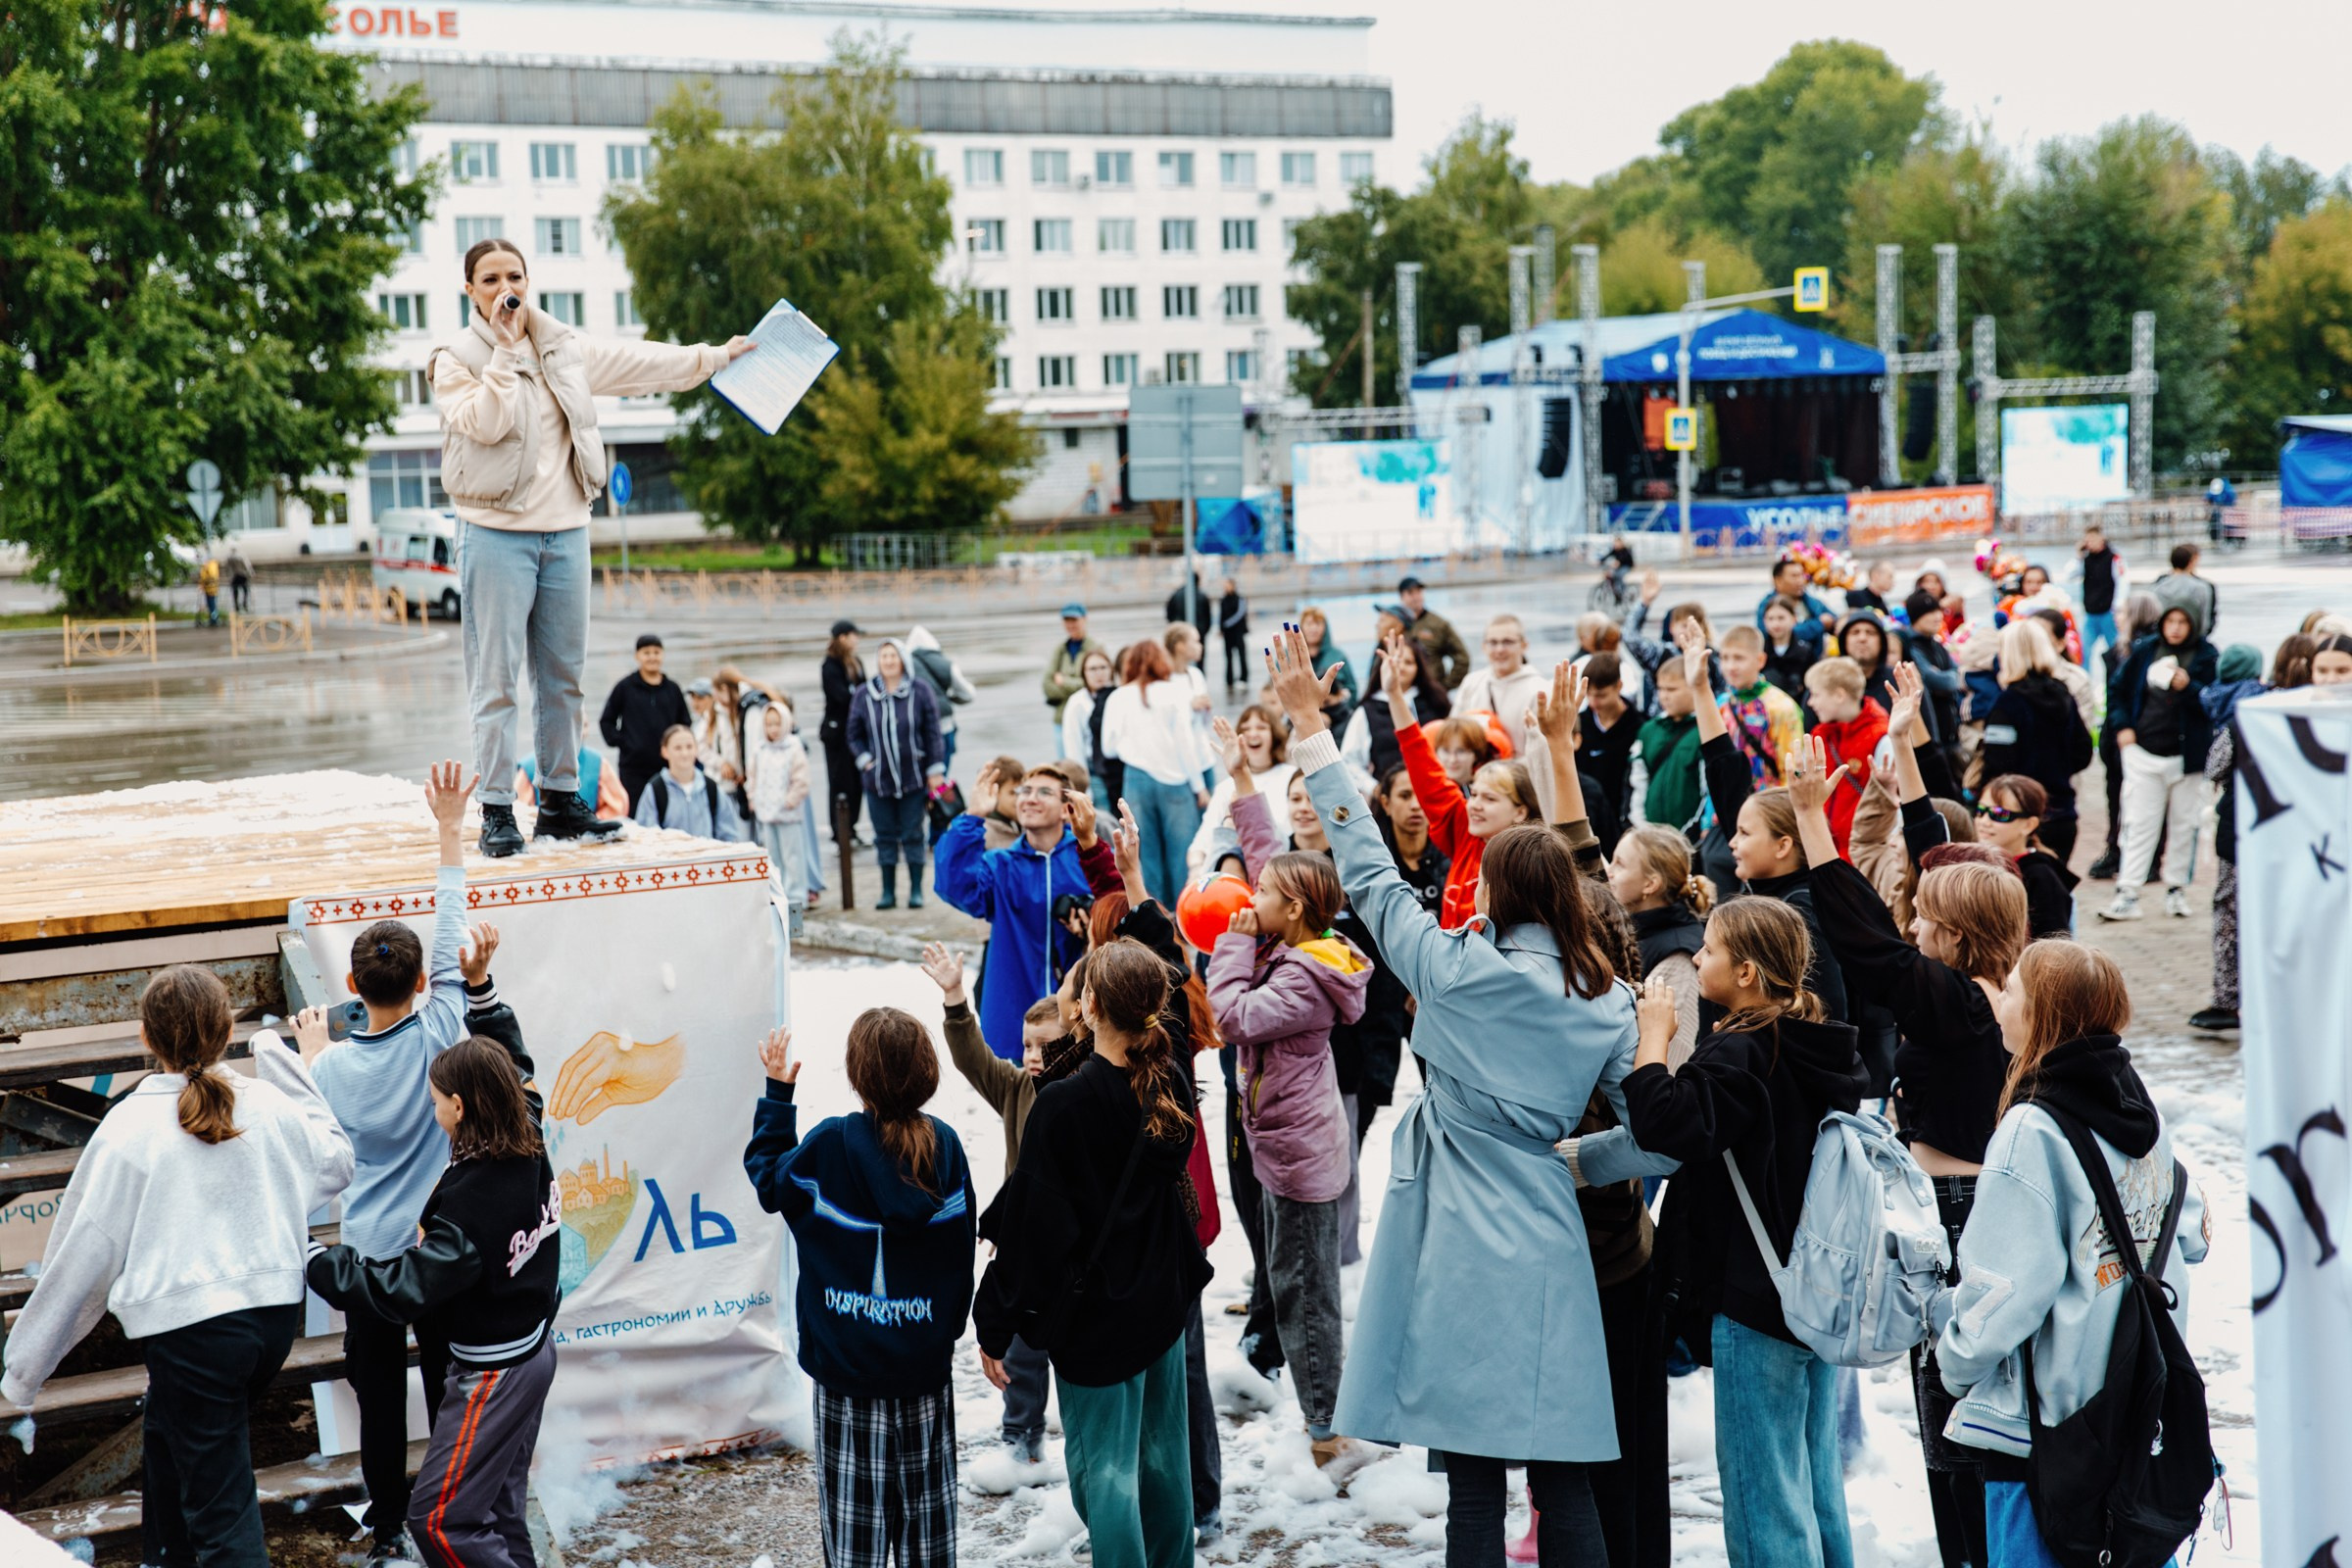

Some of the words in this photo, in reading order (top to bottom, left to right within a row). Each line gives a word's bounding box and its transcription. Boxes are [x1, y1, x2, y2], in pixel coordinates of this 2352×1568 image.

[576, 1310, 691, 1340] гастрономии
[697, 1306, 708, 1317] и
[824, 1286, 932, 1327] INSPIRATION
